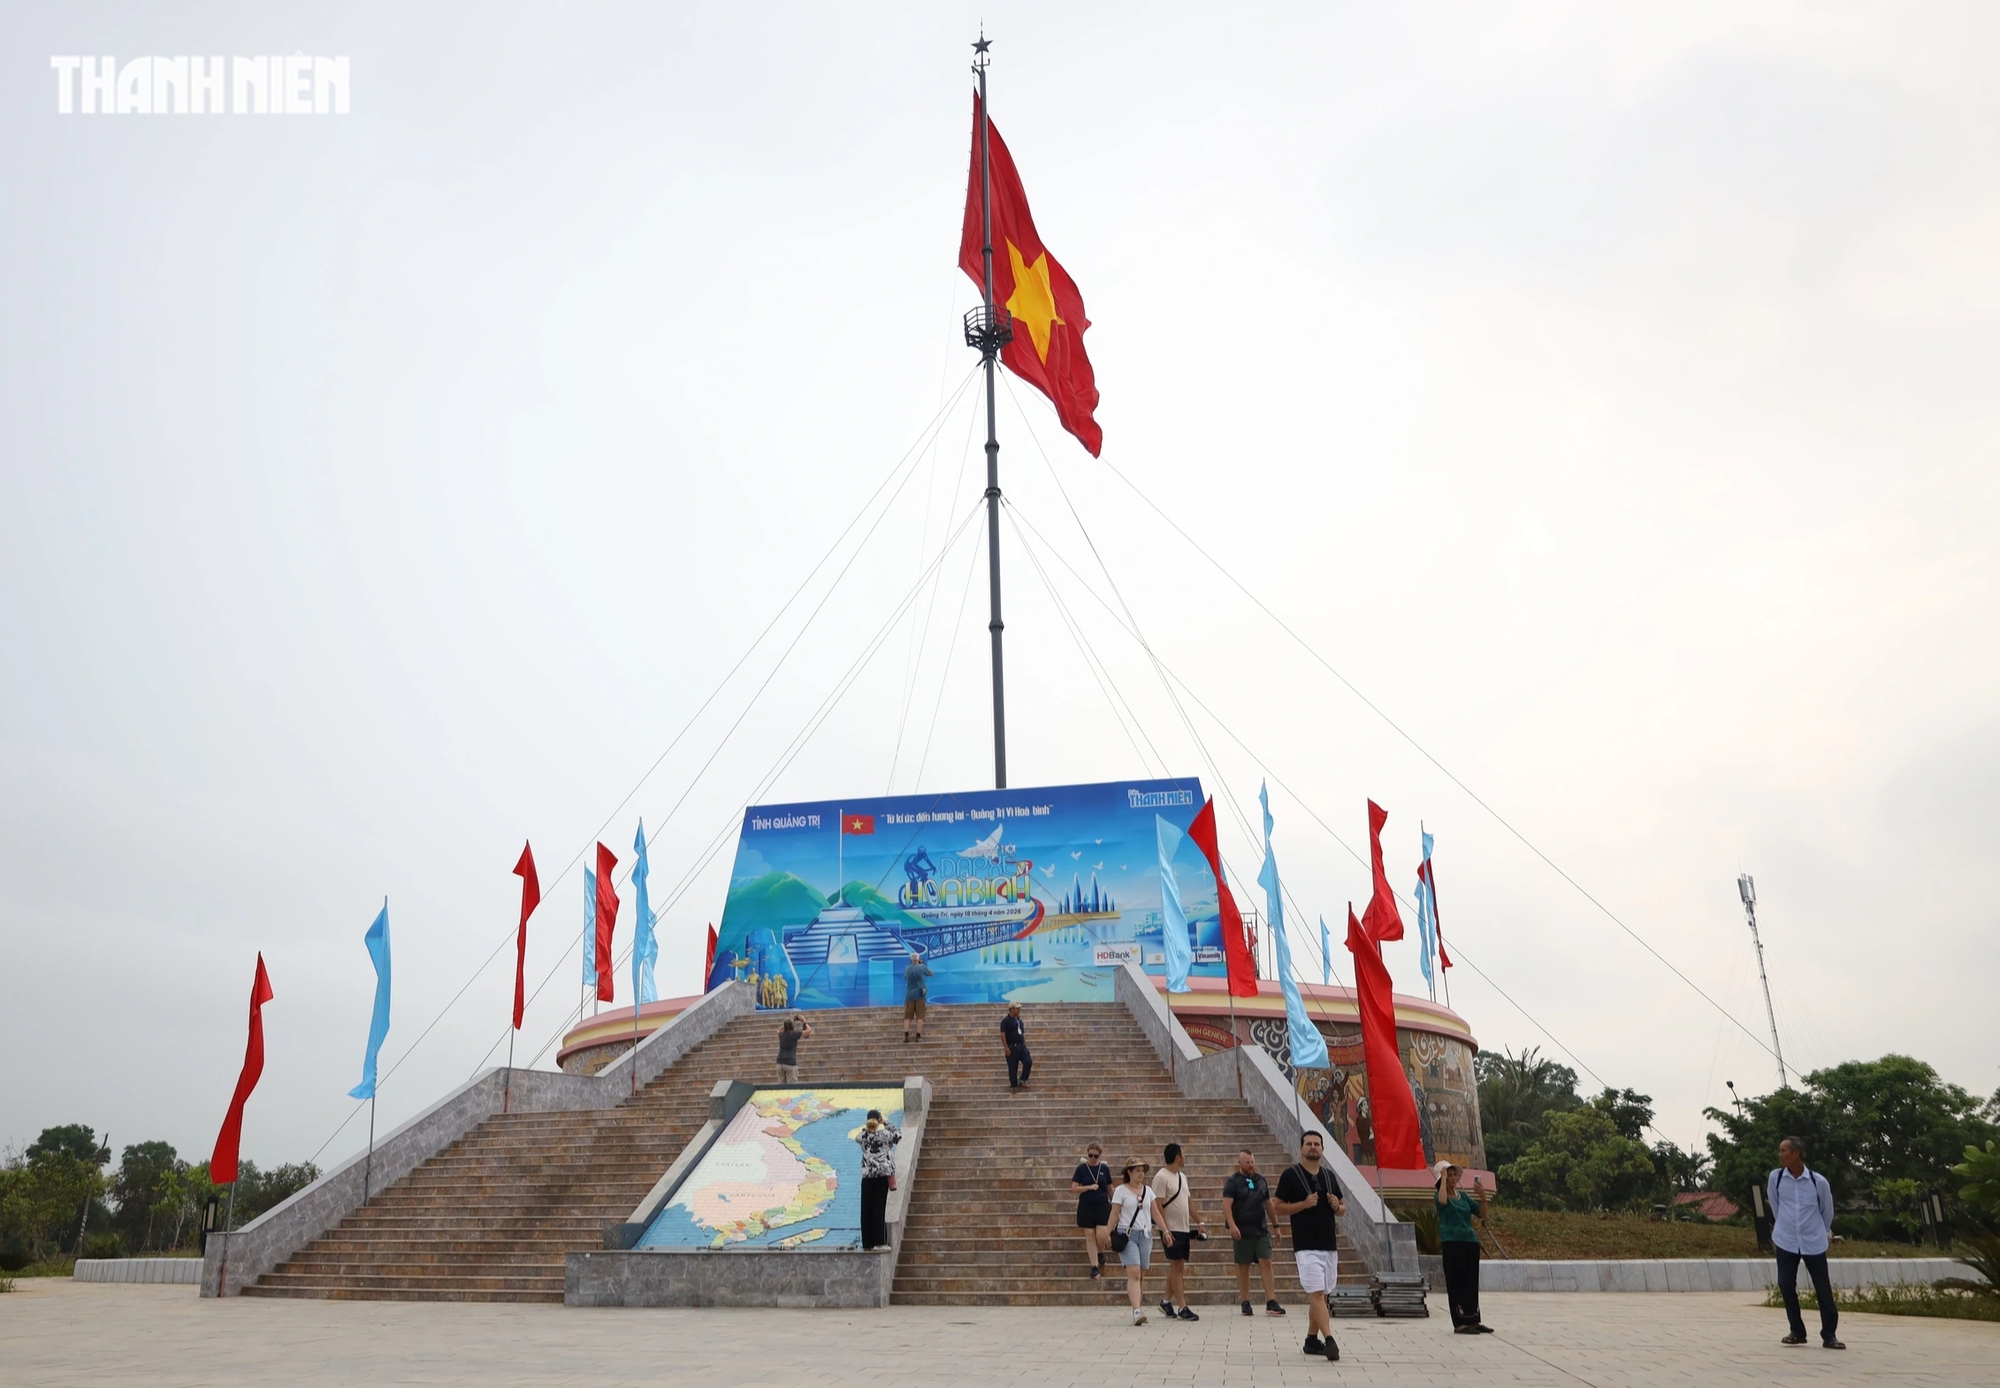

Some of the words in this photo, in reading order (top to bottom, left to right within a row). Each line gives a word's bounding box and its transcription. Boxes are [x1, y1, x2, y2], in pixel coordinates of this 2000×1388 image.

[1130, 792, 1166, 807] THANH
[752, 815, 772, 831] TỈNH
[772, 812, 806, 829] QUẢNG
[807, 814, 821, 829] TRỊ
[916, 811, 931, 823] đến
[954, 810, 965, 820] lai
[970, 808, 995, 821] Quảng
[996, 807, 1005, 819] Trị
[987, 854, 1016, 876] XE
[965, 873, 1031, 905] BÌNH
[921, 911, 940, 919] Quảng
[949, 910, 964, 918] ngày
[971, 909, 988, 917] tháng
[1006, 907, 1022, 915] 2026
[1097, 951, 1130, 960] HDBank
[1197, 952, 1221, 960] Vinamilk
